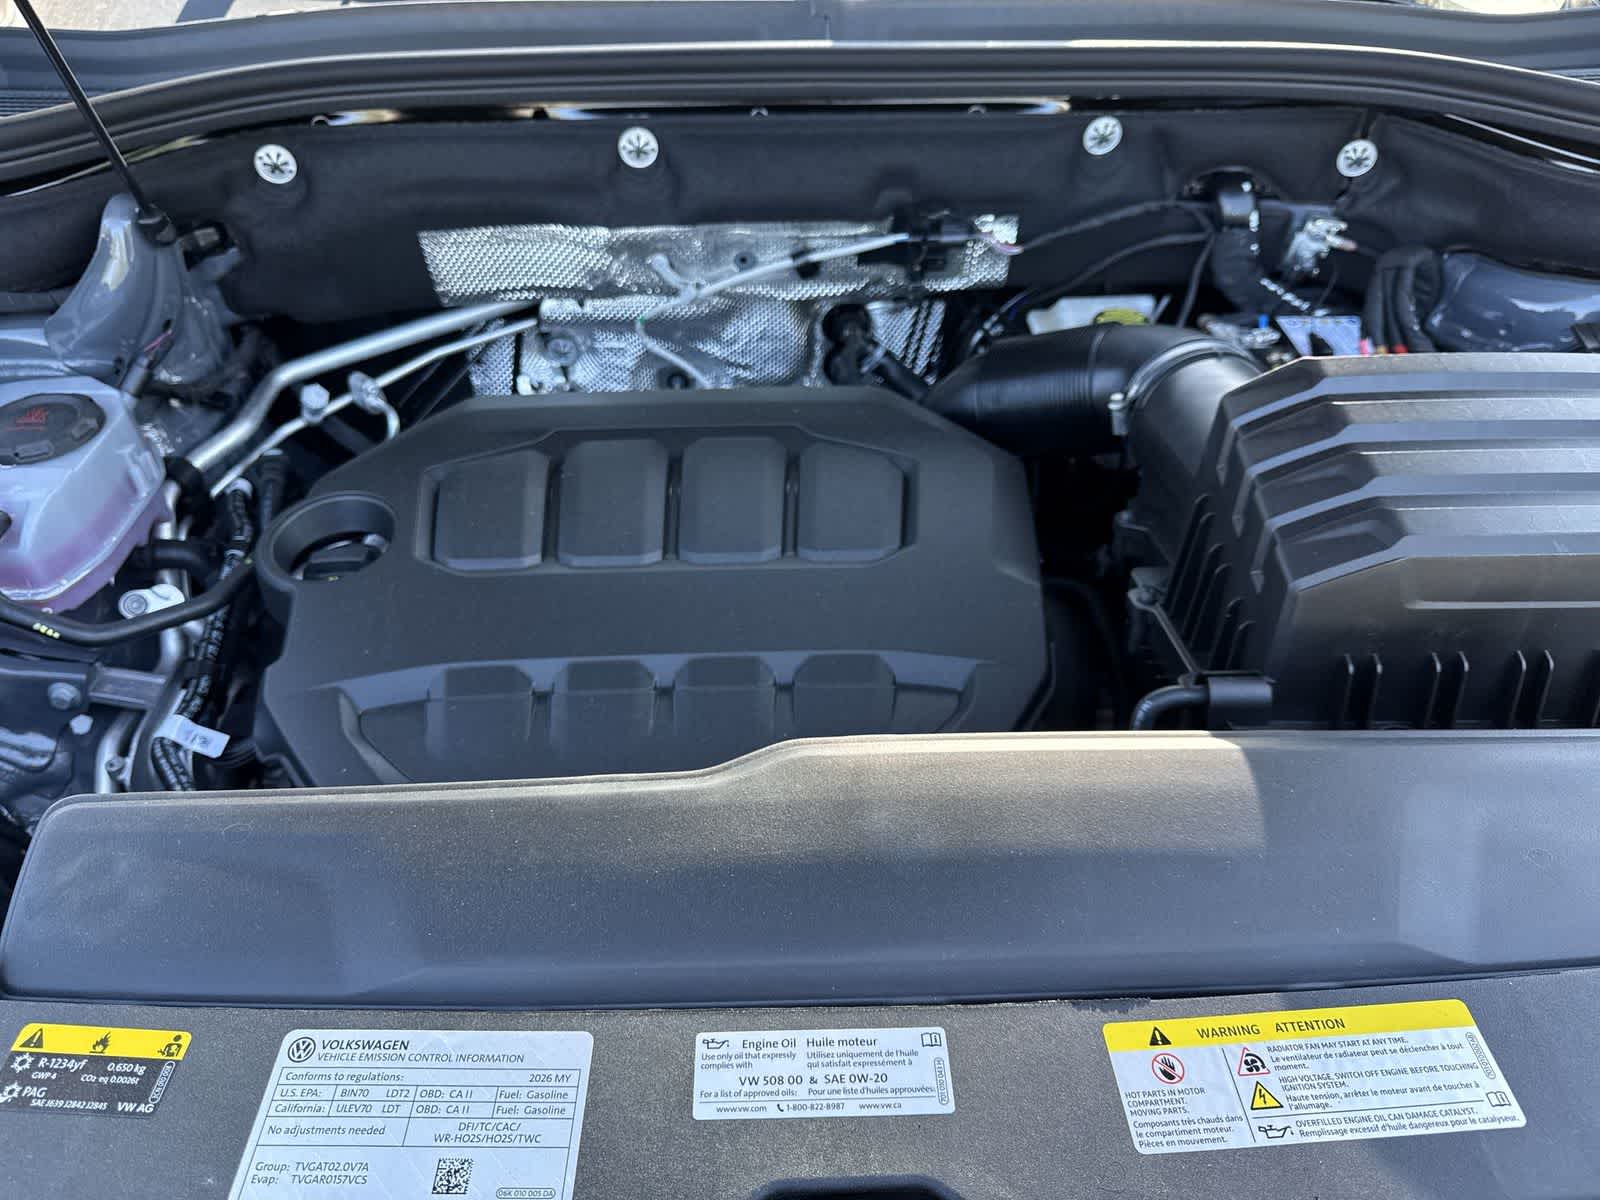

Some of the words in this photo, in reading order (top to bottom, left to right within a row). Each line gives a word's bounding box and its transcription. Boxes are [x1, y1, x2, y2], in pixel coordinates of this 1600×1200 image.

[1196, 1024, 1260, 1039] WARNING
[1275, 1018, 1346, 1033] ATTENTION
[322, 1040, 410, 1051] VOLKSWAGEN
[742, 1039, 779, 1050] Engine
[781, 1038, 796, 1048] Oil
[806, 1037, 835, 1047] Huile
[838, 1038, 877, 1046] moteur
[1266, 1043, 1305, 1053] RADIATOR
[1306, 1042, 1320, 1050] FAN
[1321, 1040, 1338, 1049] MAY
[1338, 1039, 1361, 1048] START
[1362, 1038, 1372, 1046] AT
[1372, 1038, 1386, 1046] ANY
[716, 1052, 733, 1062] only
[734, 1052, 744, 1060] oil
[745, 1052, 760, 1060] that
[762, 1051, 796, 1061] expressly
[806, 1051, 835, 1059] Utilisez
[836, 1050, 883, 1060] uniquement
[884, 1050, 894, 1058] de
[896, 1049, 919, 1057] l'huile
[1282, 1052, 1322, 1062] ventilateur
[1324, 1052, 1333, 1060] de
[1334, 1050, 1369, 1059] radiateur
[1370, 1048, 1388, 1057] peut
[1447, 1042, 1464, 1050] tout
[318, 1052, 356, 1062] VEHICLE
[358, 1052, 406, 1062] EMISSION
[407, 1053, 452, 1063] CONTROL
[455, 1054, 525, 1064] INFORMATION
[38, 1057, 89, 1072] R-1234yf
[106, 1062, 134, 1073] 0.650
[134, 1063, 147, 1076] kg
[700, 1062, 734, 1070] complies
[736, 1061, 753, 1070] with
[806, 1061, 820, 1070] qui
[820, 1060, 851, 1068] satisfait
[1274, 1063, 1309, 1071] moment.
[285, 1072, 332, 1081] Conforms
[334, 1072, 345, 1081] to
[346, 1072, 404, 1083] regulations:
[1279, 1074, 1298, 1083] HIGH
[1334, 1070, 1365, 1080] SWITCH
[1366, 1068, 1380, 1078] OFF
[1381, 1066, 1408, 1077] ENGINE
[1410, 1064, 1440, 1074] BEFORE
[1440, 1062, 1479, 1072] TOUCHING
[98, 1076, 109, 1084] eq
[529, 1074, 553, 1083] 2026
[554, 1074, 572, 1083] MY
[738, 1076, 760, 1086] VW
[763, 1076, 785, 1086] 508
[788, 1075, 803, 1085] 00
[809, 1076, 818, 1084] &
[824, 1074, 846, 1084] SAE
[848, 1072, 888, 1084] 0W-20
[22, 1086, 48, 1098] PAG
[808, 1088, 825, 1096] Pour
[826, 1088, 842, 1096] une
[842, 1087, 858, 1095] liste
[860, 1086, 889, 1094] d'huiles
[1282, 1083, 1319, 1092] IGNITION
[1320, 1081, 1349, 1090] SYSTEM.
[1286, 1094, 1310, 1102] Haute
[1311, 1092, 1342, 1102] tension,
[1380, 1087, 1408, 1096] moteur
[1409, 1086, 1432, 1094] avant
[1433, 1084, 1442, 1092] de
[1442, 1082, 1473, 1091] toucher
[280, 1088, 298, 1098] U.S.
[300, 1088, 322, 1098] EPA:
[340, 1088, 370, 1098] BIN70
[386, 1089, 410, 1098] LDT2
[420, 1089, 445, 1098] OBD:
[450, 1090, 464, 1098] CA
[500, 1090, 522, 1100] Fuel:
[526, 1090, 568, 1100] Gasoline
[700, 1090, 713, 1098] For
[720, 1090, 732, 1098] list
[733, 1090, 742, 1098] of
[743, 1089, 780, 1099] approved
[781, 1088, 798, 1097] oils:
[1124, 1091, 1140, 1099] HOT
[1142, 1090, 1166, 1098] PARTS
[1168, 1088, 1176, 1096] IN
[1178, 1088, 1206, 1096] MOTOR
[118, 1102, 137, 1112] VW
[136, 1103, 154, 1113] AG
[274, 1103, 326, 1113] California:
[786, 1103, 845, 1112] 1-800-822-8987
[859, 1102, 902, 1110] www.vw.ca
[1128, 1098, 1187, 1108] COMPARTMENT.
[336, 1104, 372, 1113] ULEV70
[382, 1104, 400, 1114] LDT
[416, 1104, 442, 1114] OBD:
[446, 1105, 460, 1114] CA
[496, 1106, 520, 1115] Fuel:
[524, 1106, 566, 1116] Gasoline
[716, 1105, 768, 1113] www.vw.com
[1130, 1108, 1162, 1117] MOVING
[1163, 1107, 1190, 1116] PARTS.
[1133, 1119, 1180, 1130] Composants
[1182, 1118, 1196, 1126] très
[1197, 1116, 1224, 1125] chauds
[1225, 1114, 1244, 1122] dans
[1296, 1117, 1342, 1128] OVERFILLED
[1343, 1115, 1374, 1126] ENGINE
[1374, 1114, 1387, 1124] OIL
[1388, 1112, 1404, 1122] CAN
[1406, 1110, 1438, 1120] DAMAGE
[1440, 1106, 1478, 1117] CATALYST.
[268, 1125, 282, 1135] No
[283, 1124, 346, 1138] adjustments
[348, 1126, 386, 1136] needed
[458, 1122, 522, 1132] DFI/TC/CAC/
[1300, 1128, 1350, 1138] Remplissage
[1350, 1125, 1380, 1134] excessif
[1381, 1121, 1408, 1132] d'huile
[1408, 1120, 1450, 1130] dangereux
[1452, 1118, 1468, 1128] pour
[1136, 1130, 1144, 1138] le
[1145, 1128, 1201, 1138] compartiment
[434, 1134, 542, 1144] WR-HO2S/HO2S/TWC
[1139, 1138, 1165, 1148] Pièces
[255, 1161, 290, 1174] Group:
[250, 1174, 279, 1186] Evap:
